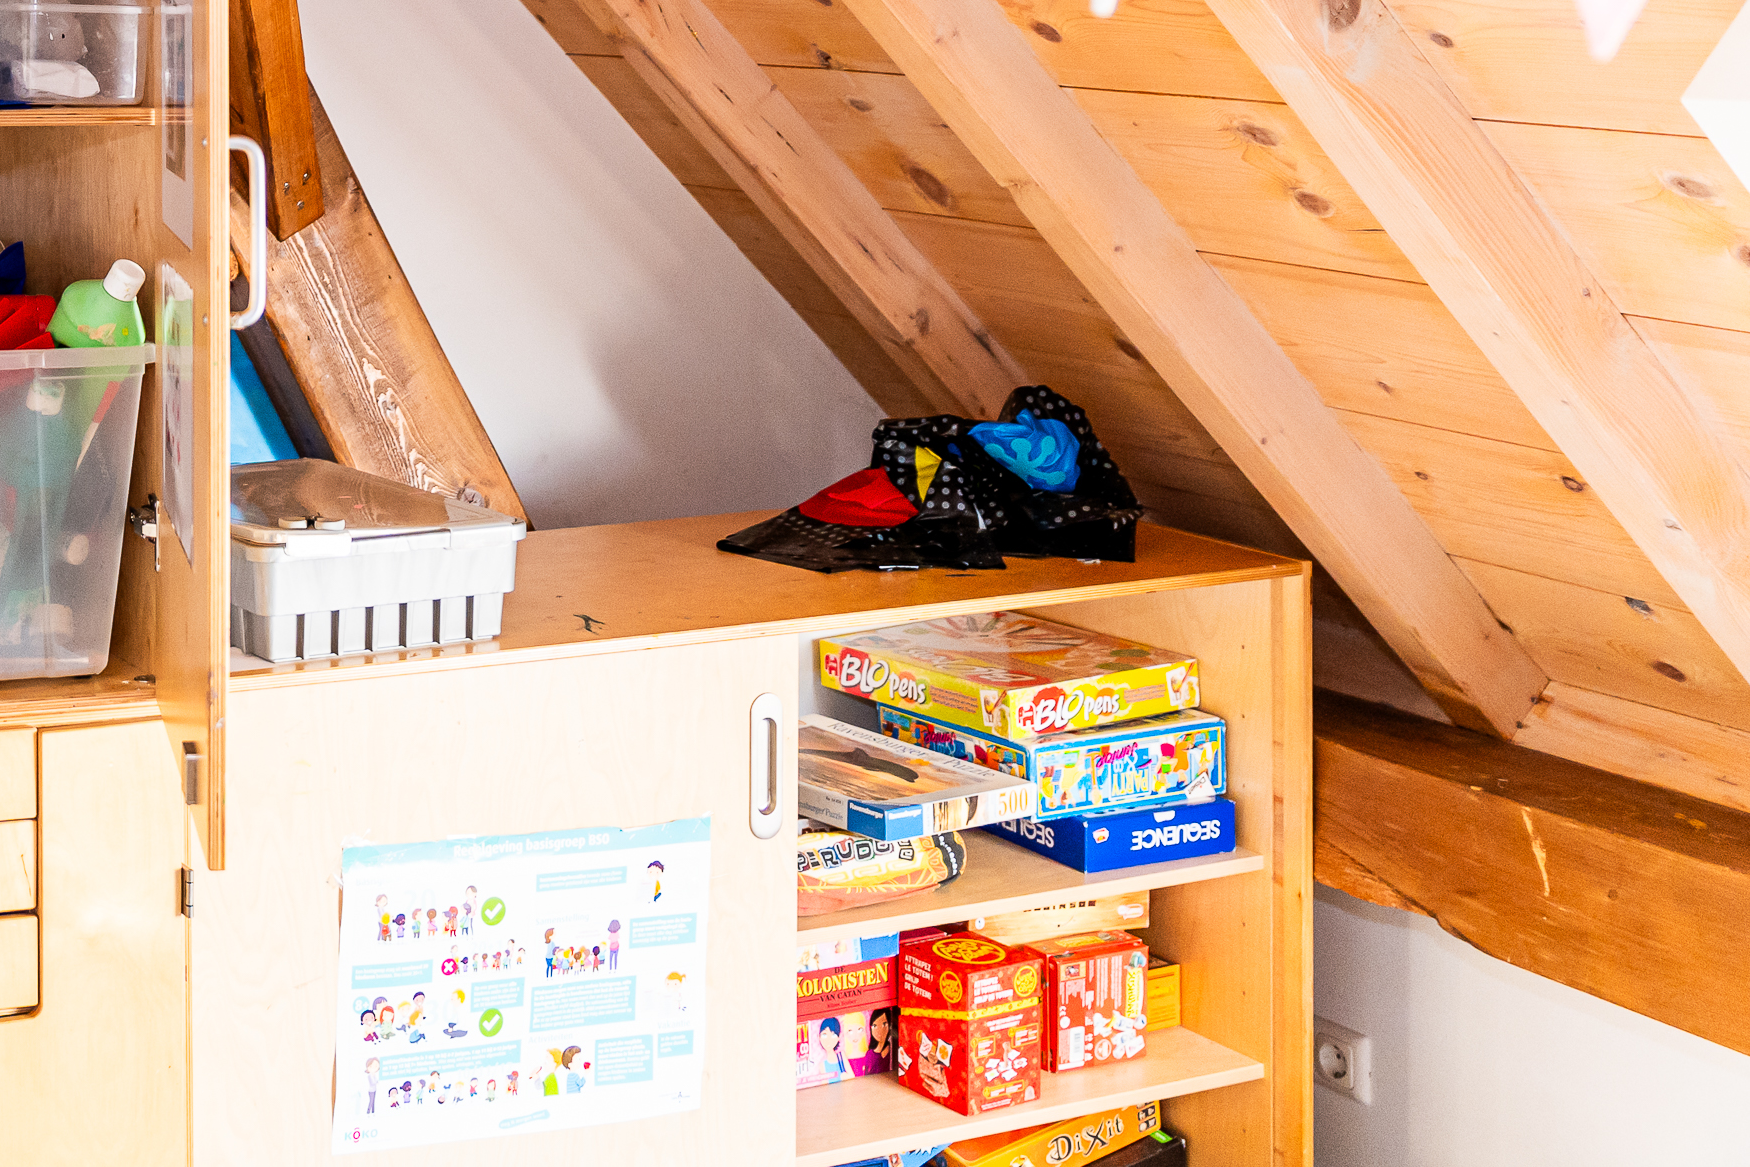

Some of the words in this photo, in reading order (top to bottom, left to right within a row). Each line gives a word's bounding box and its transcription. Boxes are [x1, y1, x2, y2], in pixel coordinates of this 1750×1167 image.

[889, 672, 927, 704] pens
[1084, 694, 1120, 721] pens
[828, 721, 927, 757] Ravensburger
[944, 758, 995, 777] Puzzle
[1111, 769, 1149, 797] PARTY
[998, 788, 1028, 817] 500
[453, 839, 522, 859] Regelgeving
[525, 835, 586, 856] basisgroep
[588, 833, 610, 847] BSO
[1130, 819, 1221, 851] SEQUENCE
[535, 912, 590, 926] Samenstelling
[904, 964, 911, 972] LE
[905, 955, 932, 972] ATTRAPEZ
[354, 999, 369, 1011] 8+
[819, 994, 835, 1002] VAN
[837, 989, 862, 999] CATAN
[528, 1032, 573, 1044] Activiteiten
